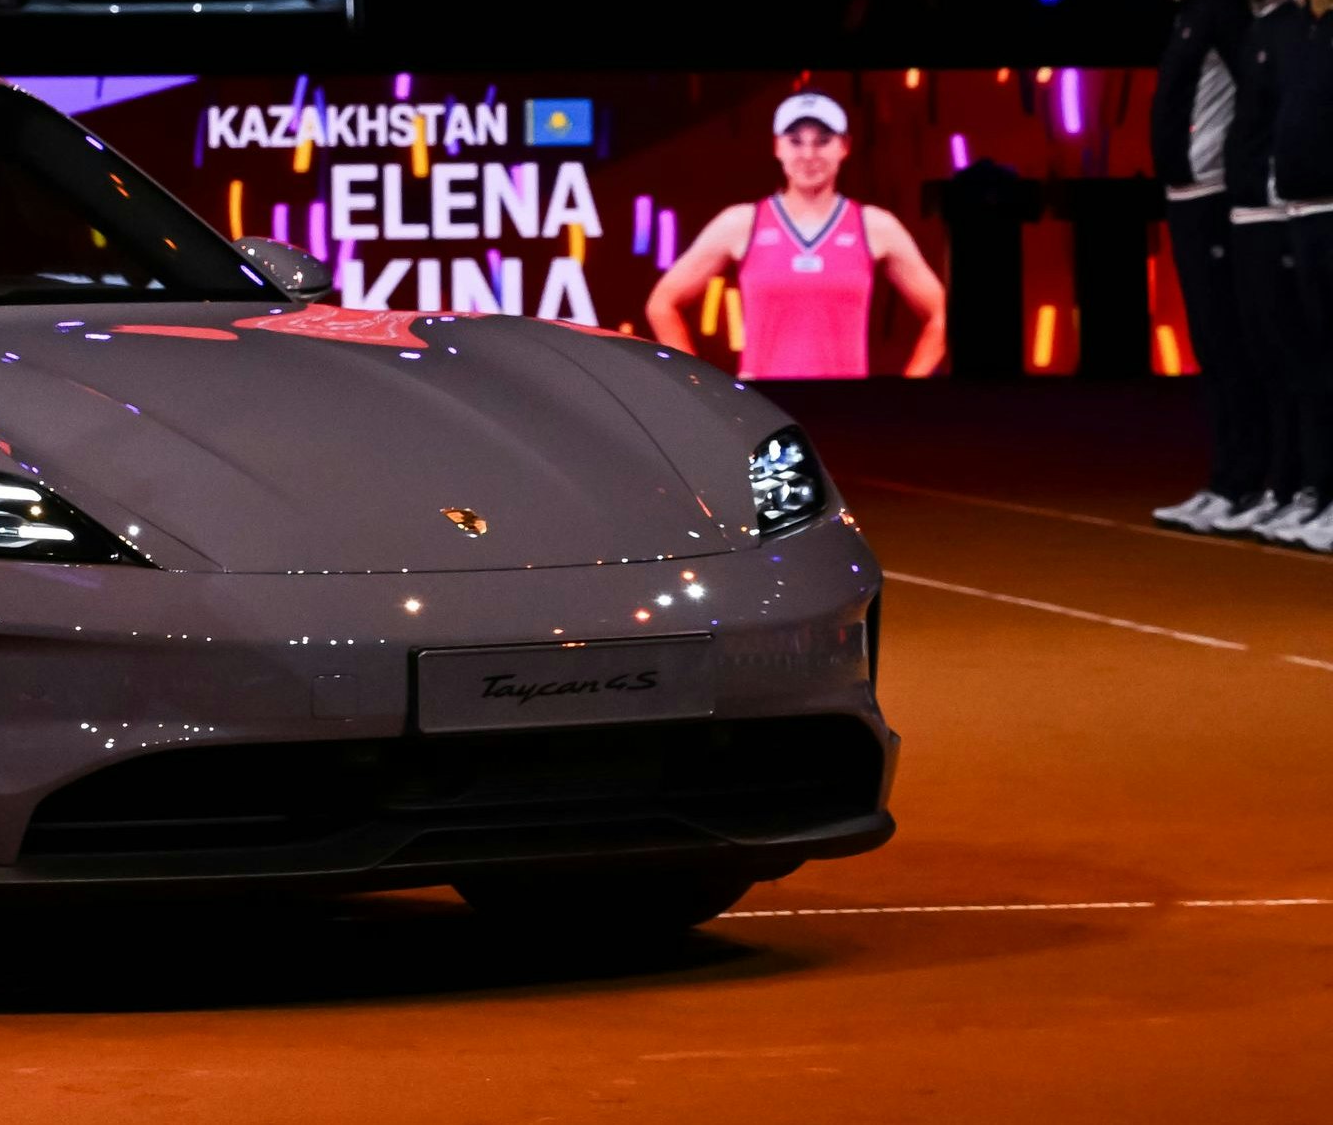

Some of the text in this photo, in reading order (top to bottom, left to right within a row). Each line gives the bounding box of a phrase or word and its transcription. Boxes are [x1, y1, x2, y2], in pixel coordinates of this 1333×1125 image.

[207, 103, 508, 149] KAZAKHSTAN
[331, 161, 603, 240] ELENA
[480, 673, 600, 706] Taycan
